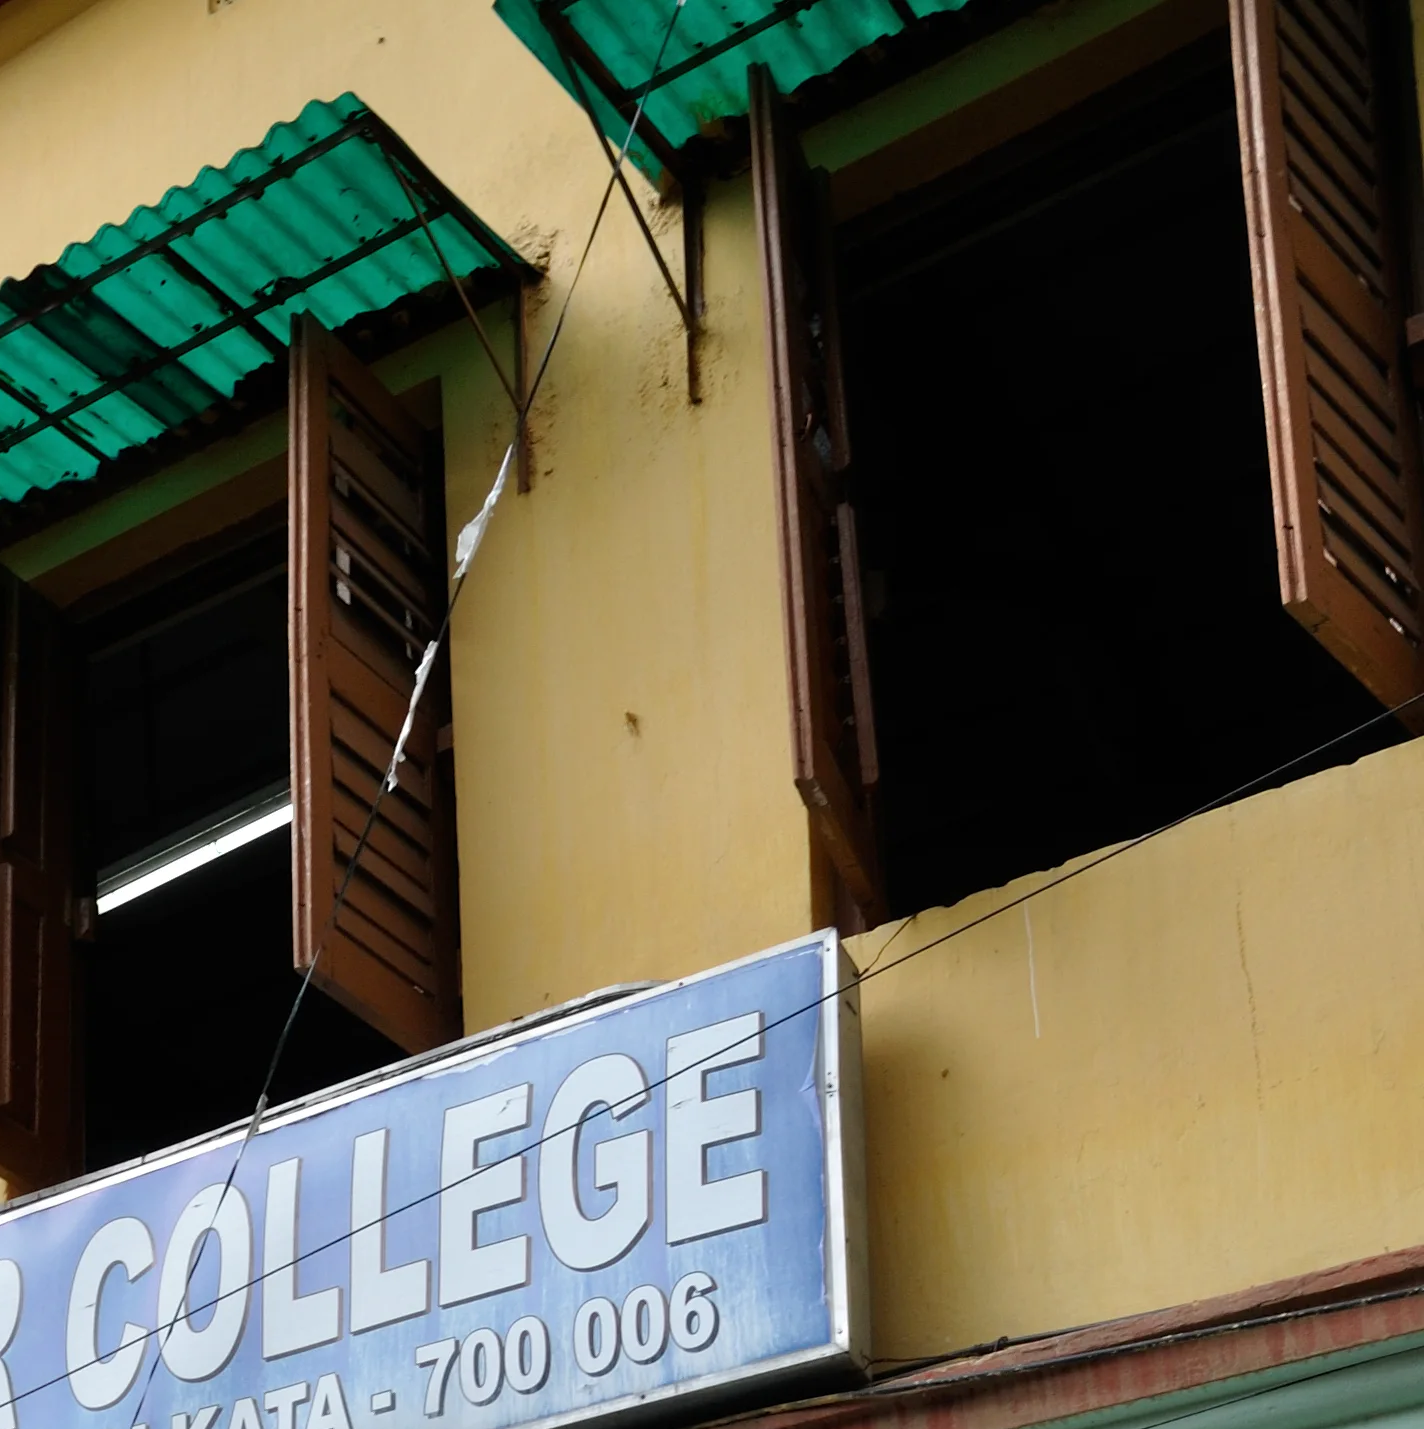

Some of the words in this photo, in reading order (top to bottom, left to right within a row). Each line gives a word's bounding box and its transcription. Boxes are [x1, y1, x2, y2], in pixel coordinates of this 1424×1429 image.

[66, 1011, 769, 1412] COLLEGE
[415, 1315, 550, 1418] 700
[574, 1271, 721, 1378] 006
